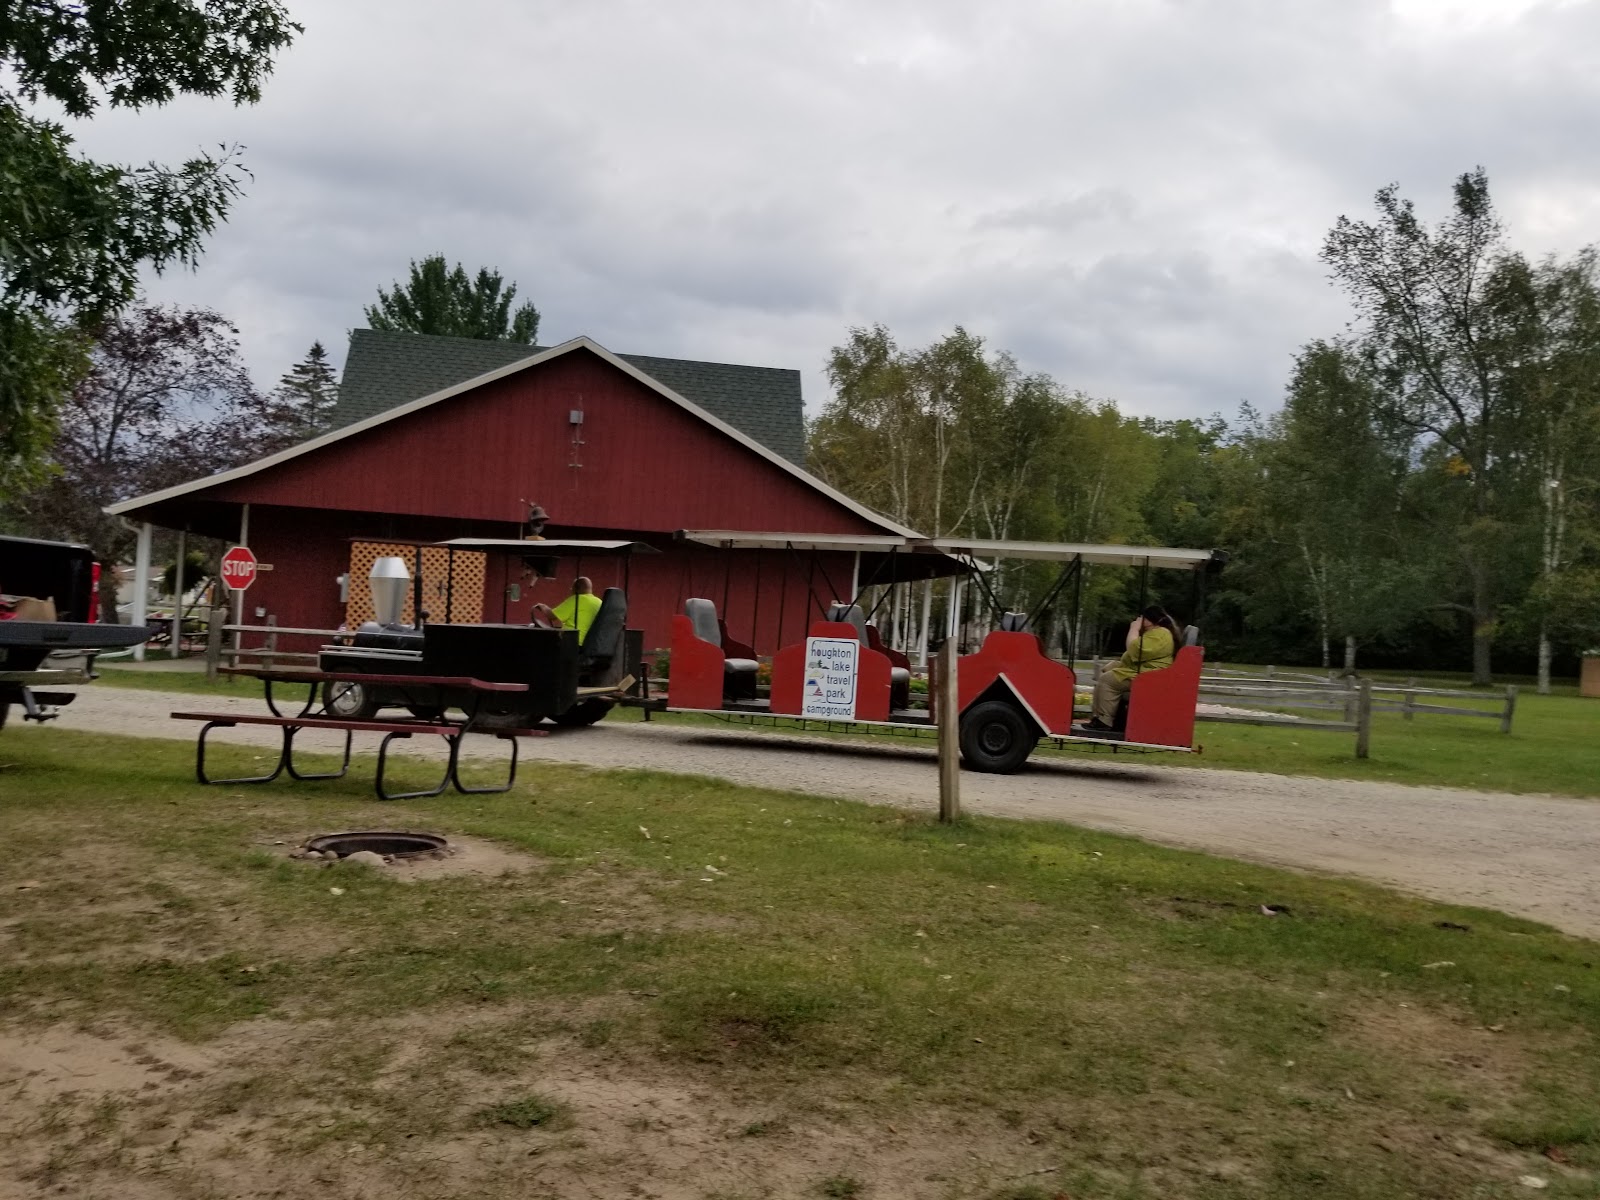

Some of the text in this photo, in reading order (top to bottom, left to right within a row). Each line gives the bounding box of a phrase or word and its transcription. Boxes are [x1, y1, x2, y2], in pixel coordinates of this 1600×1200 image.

[223, 560, 253, 576] STOP
[811, 648, 851, 659] houghton
[832, 661, 850, 671] lake
[827, 675, 850, 685] travel
[827, 689, 845, 698] park
[807, 705, 851, 716] campground
